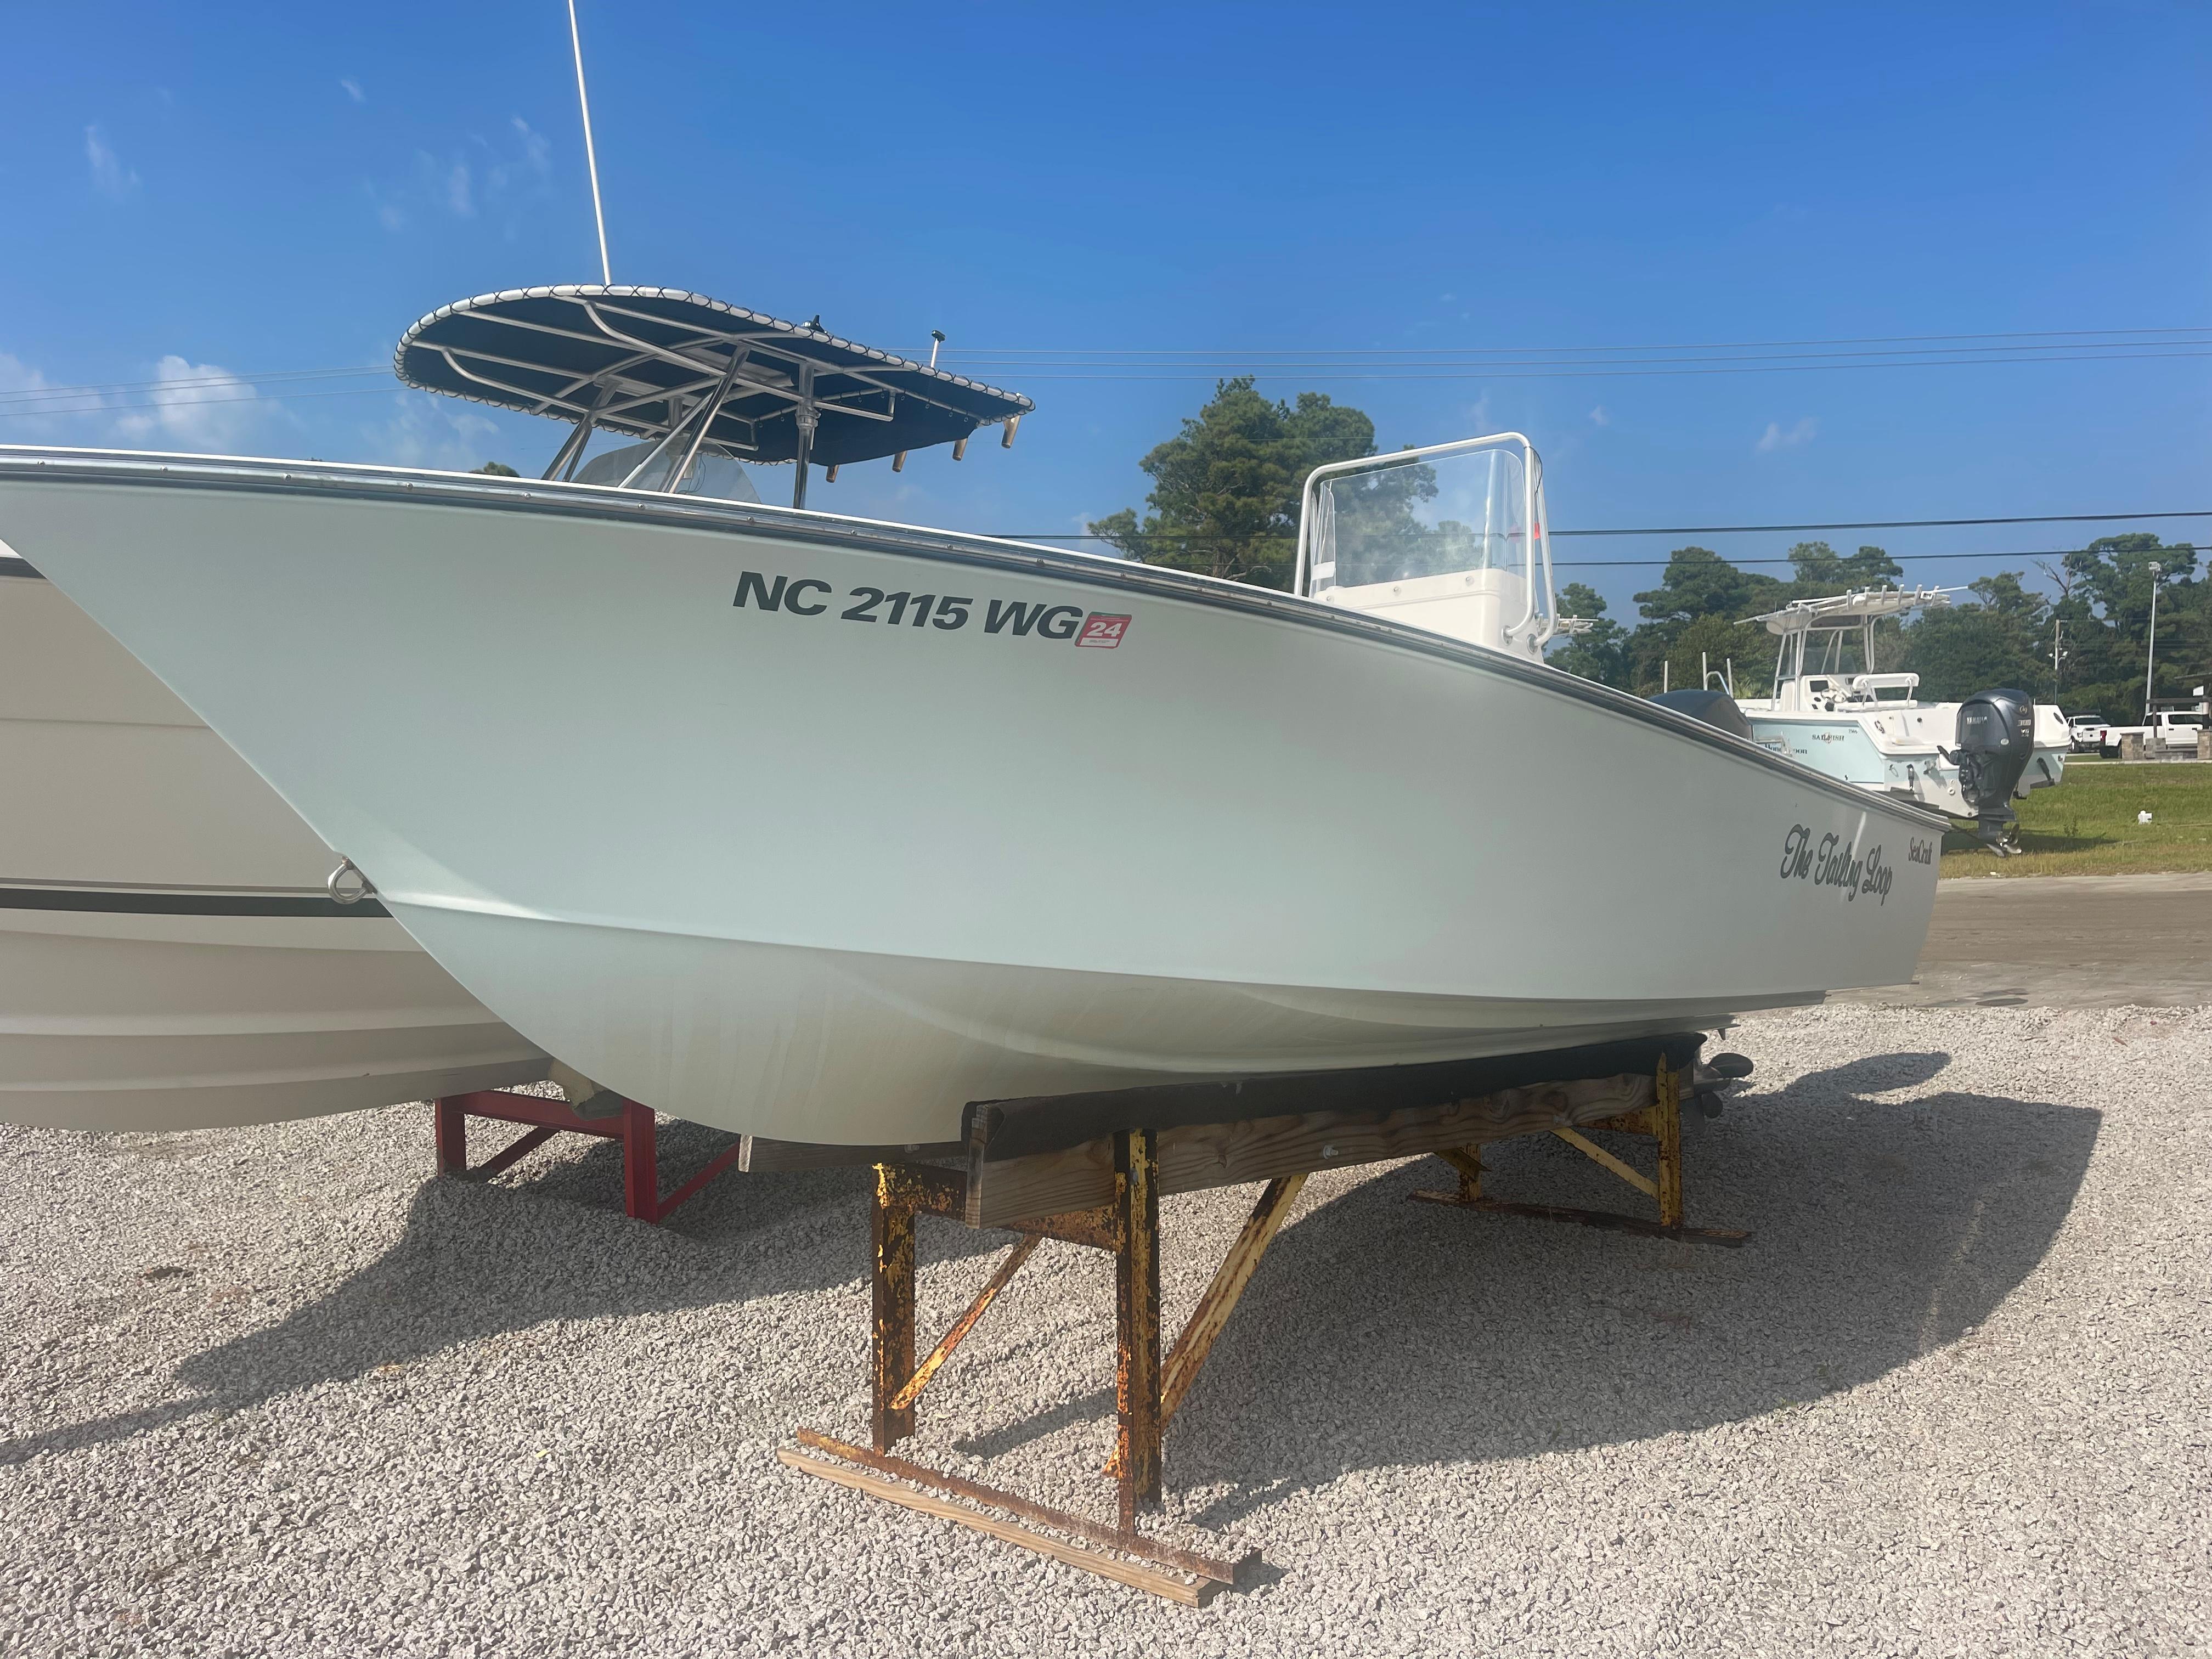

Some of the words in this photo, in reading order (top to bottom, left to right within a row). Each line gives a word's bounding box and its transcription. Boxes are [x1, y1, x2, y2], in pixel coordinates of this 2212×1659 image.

[732, 571, 832, 616] NC
[840, 586, 974, 630] 2115
[984, 600, 1084, 639] WG
[1087, 622, 1122, 637] 24
[1967, 716, 1988, 725] YAMAHA
[1780, 823, 1813, 879] The
[1861, 844, 1893, 906] Loop
